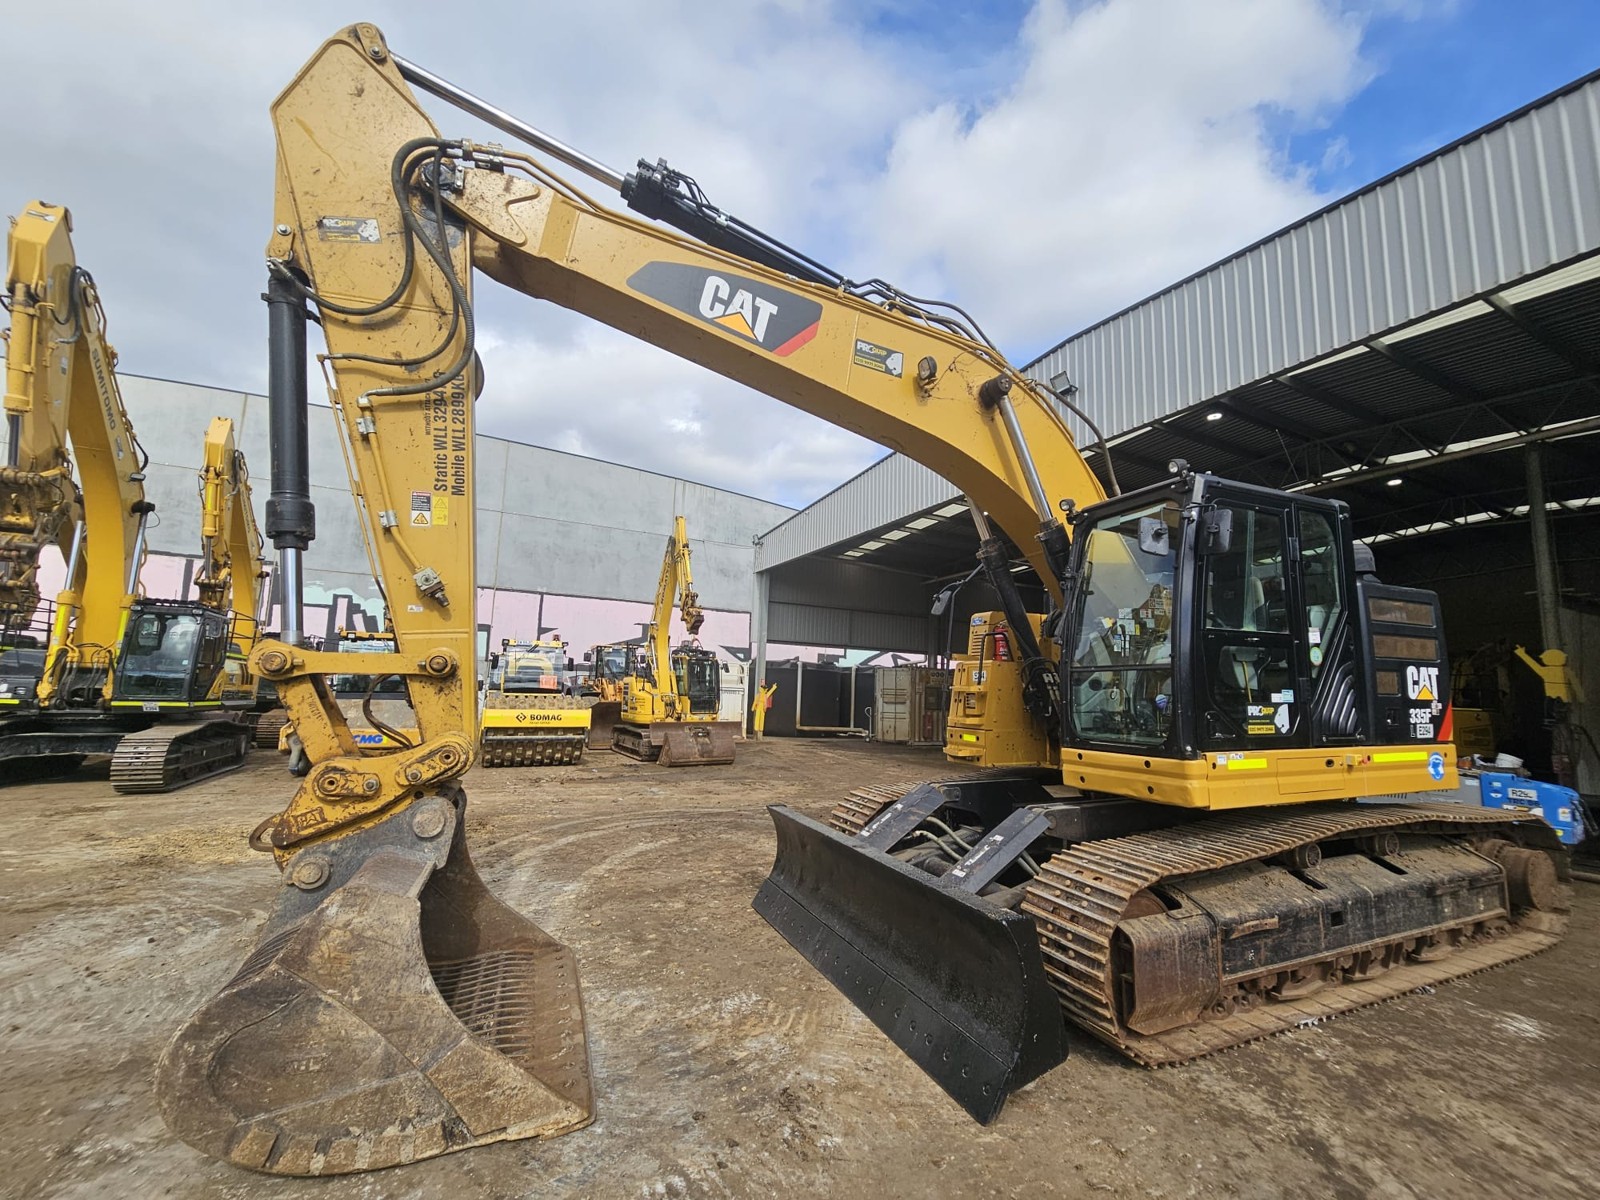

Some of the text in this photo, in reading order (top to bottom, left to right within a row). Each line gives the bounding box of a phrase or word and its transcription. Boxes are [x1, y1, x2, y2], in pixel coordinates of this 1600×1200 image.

[699, 275, 778, 343] CAT
[92, 348, 116, 430] SUMITOMO
[433, 426, 448, 450] WLL
[451, 427, 465, 451] WLL
[433, 454, 448, 491] Static
[451, 455, 465, 496] Mobile
[1406, 665, 1438, 700] CAT
[1409, 708, 1432, 724] 335F
